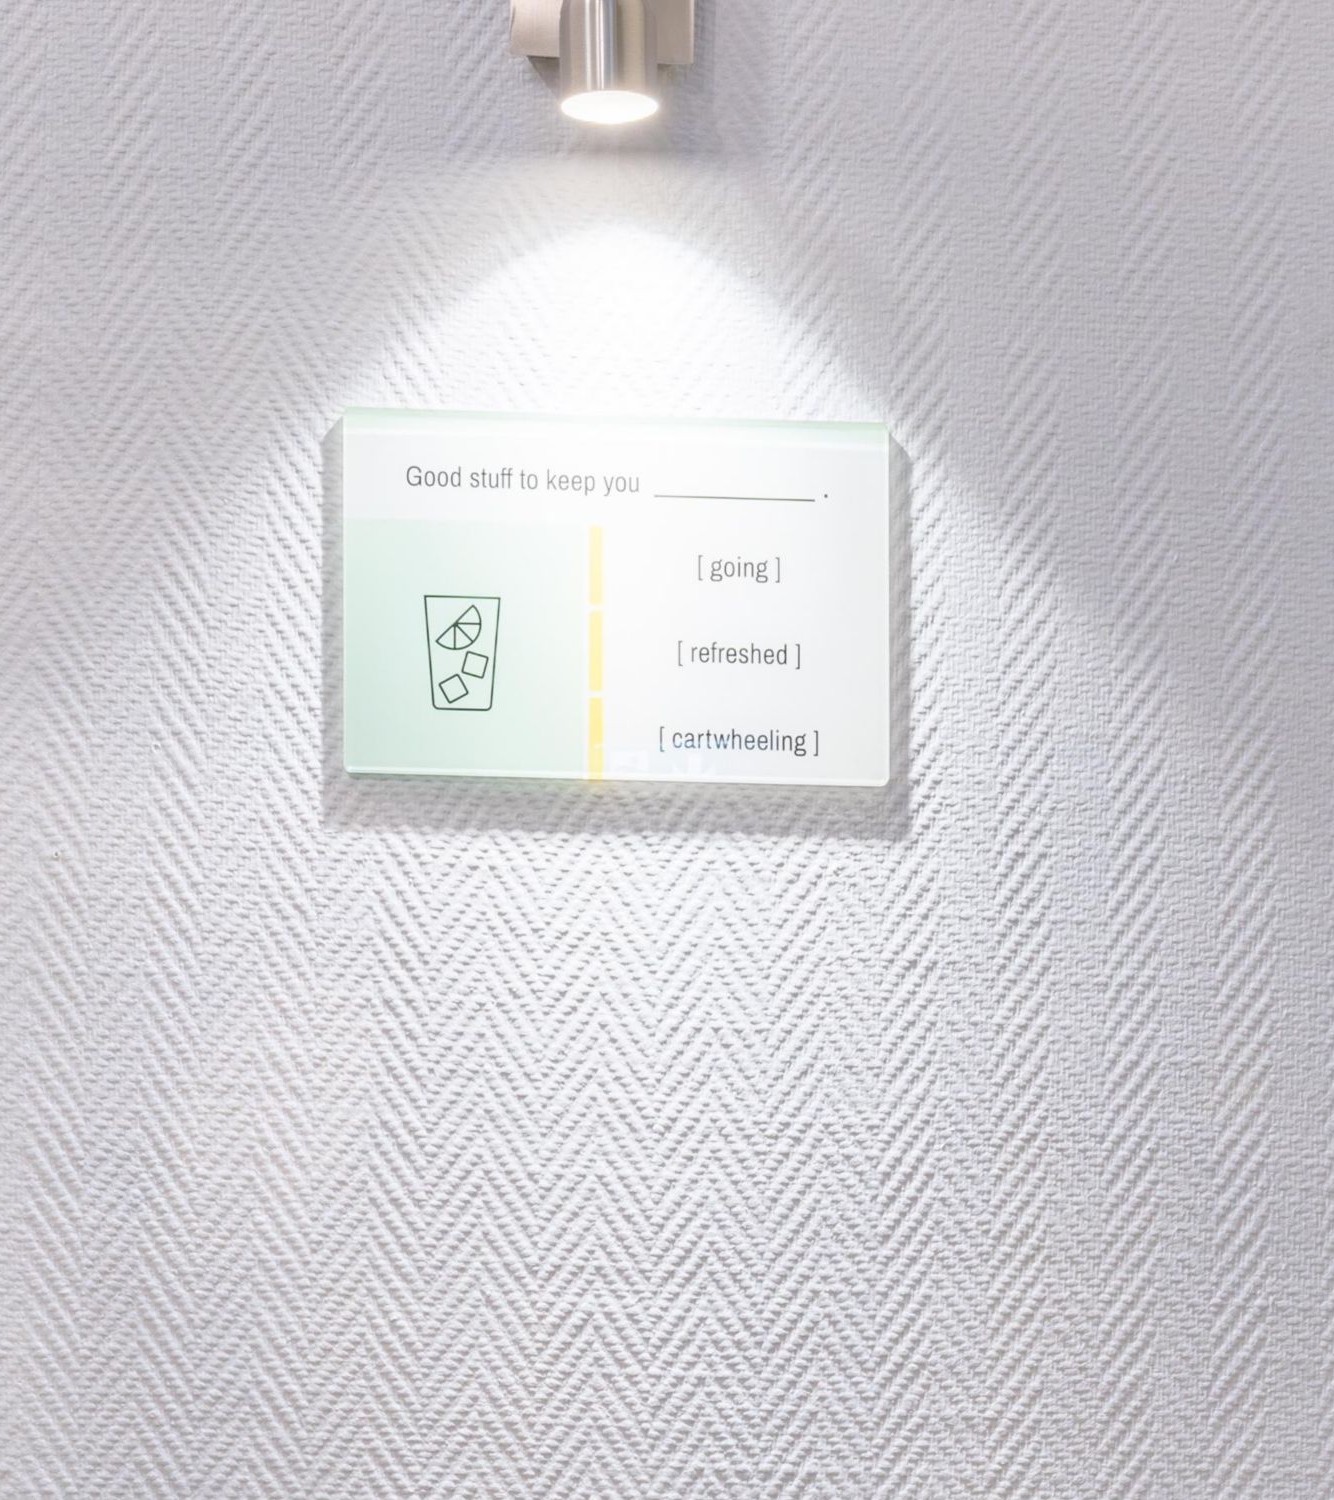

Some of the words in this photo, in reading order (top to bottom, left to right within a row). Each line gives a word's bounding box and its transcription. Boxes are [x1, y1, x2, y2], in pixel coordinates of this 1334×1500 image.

[405, 465, 462, 488] Good
[469, 467, 513, 489] stuff
[519, 469, 538, 490] to
[546, 468, 596, 496] keep
[603, 476, 640, 497] you
[709, 555, 769, 584] going
[690, 641, 788, 667] refreshed
[671, 727, 807, 757] cartwheeling
